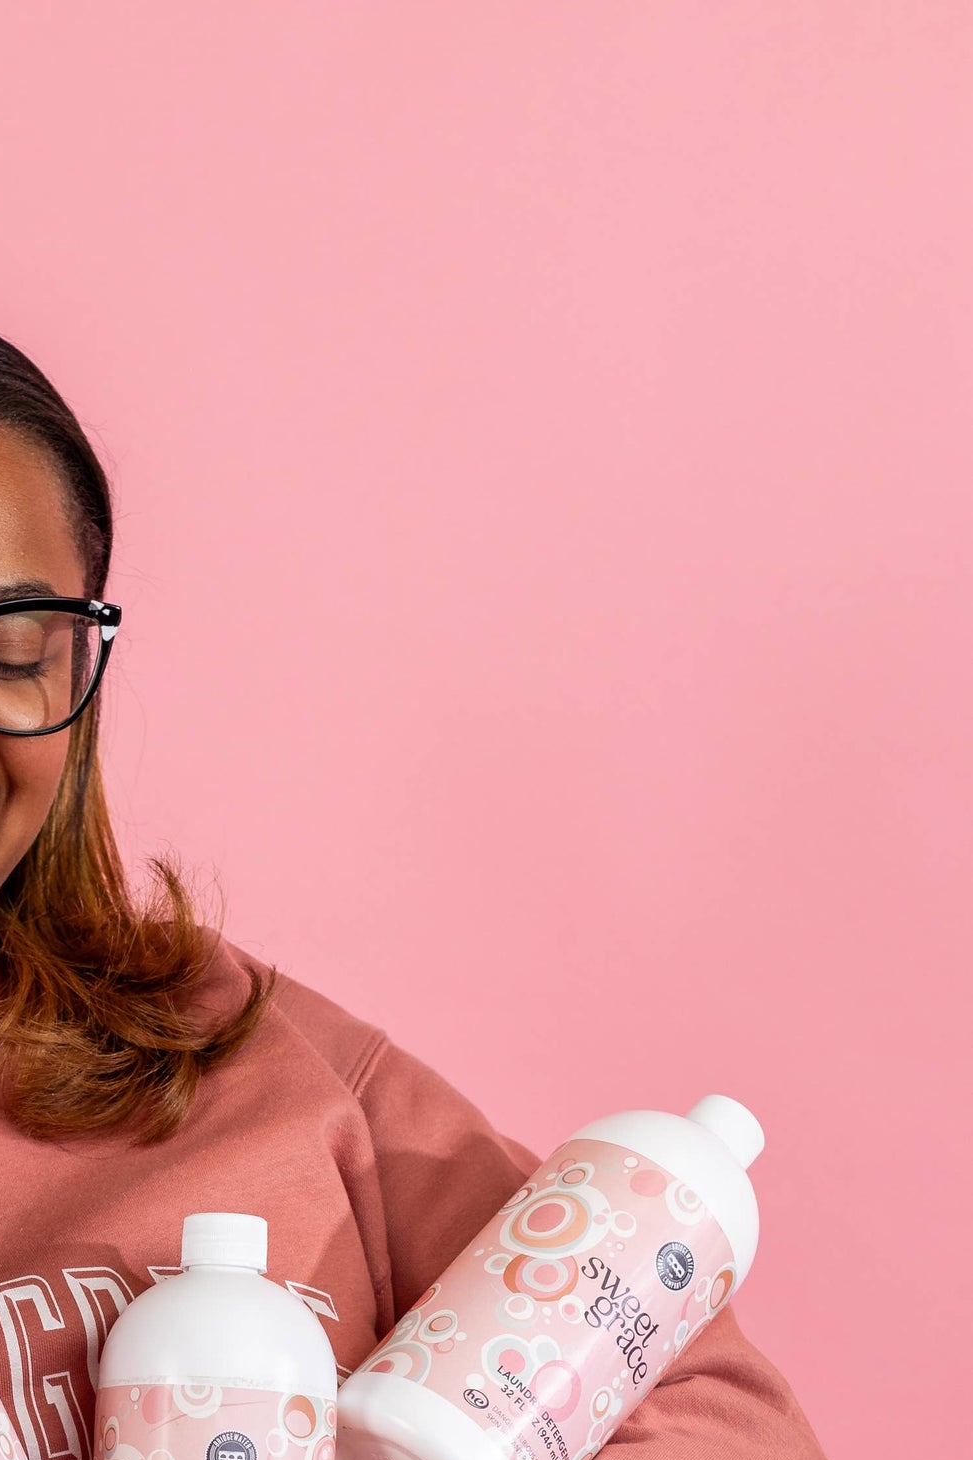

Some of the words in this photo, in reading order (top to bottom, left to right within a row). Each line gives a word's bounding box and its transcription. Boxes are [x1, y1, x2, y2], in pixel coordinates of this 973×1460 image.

[581, 1257, 659, 1348] sweet
[497, 1365, 541, 1410] LAUNDR
[213, 1433, 252, 1450] BRIDGEWATER
[500, 1384, 514, 1399] 32
[514, 1397, 527, 1412] FL
[537, 1427, 552, 1450] (946
